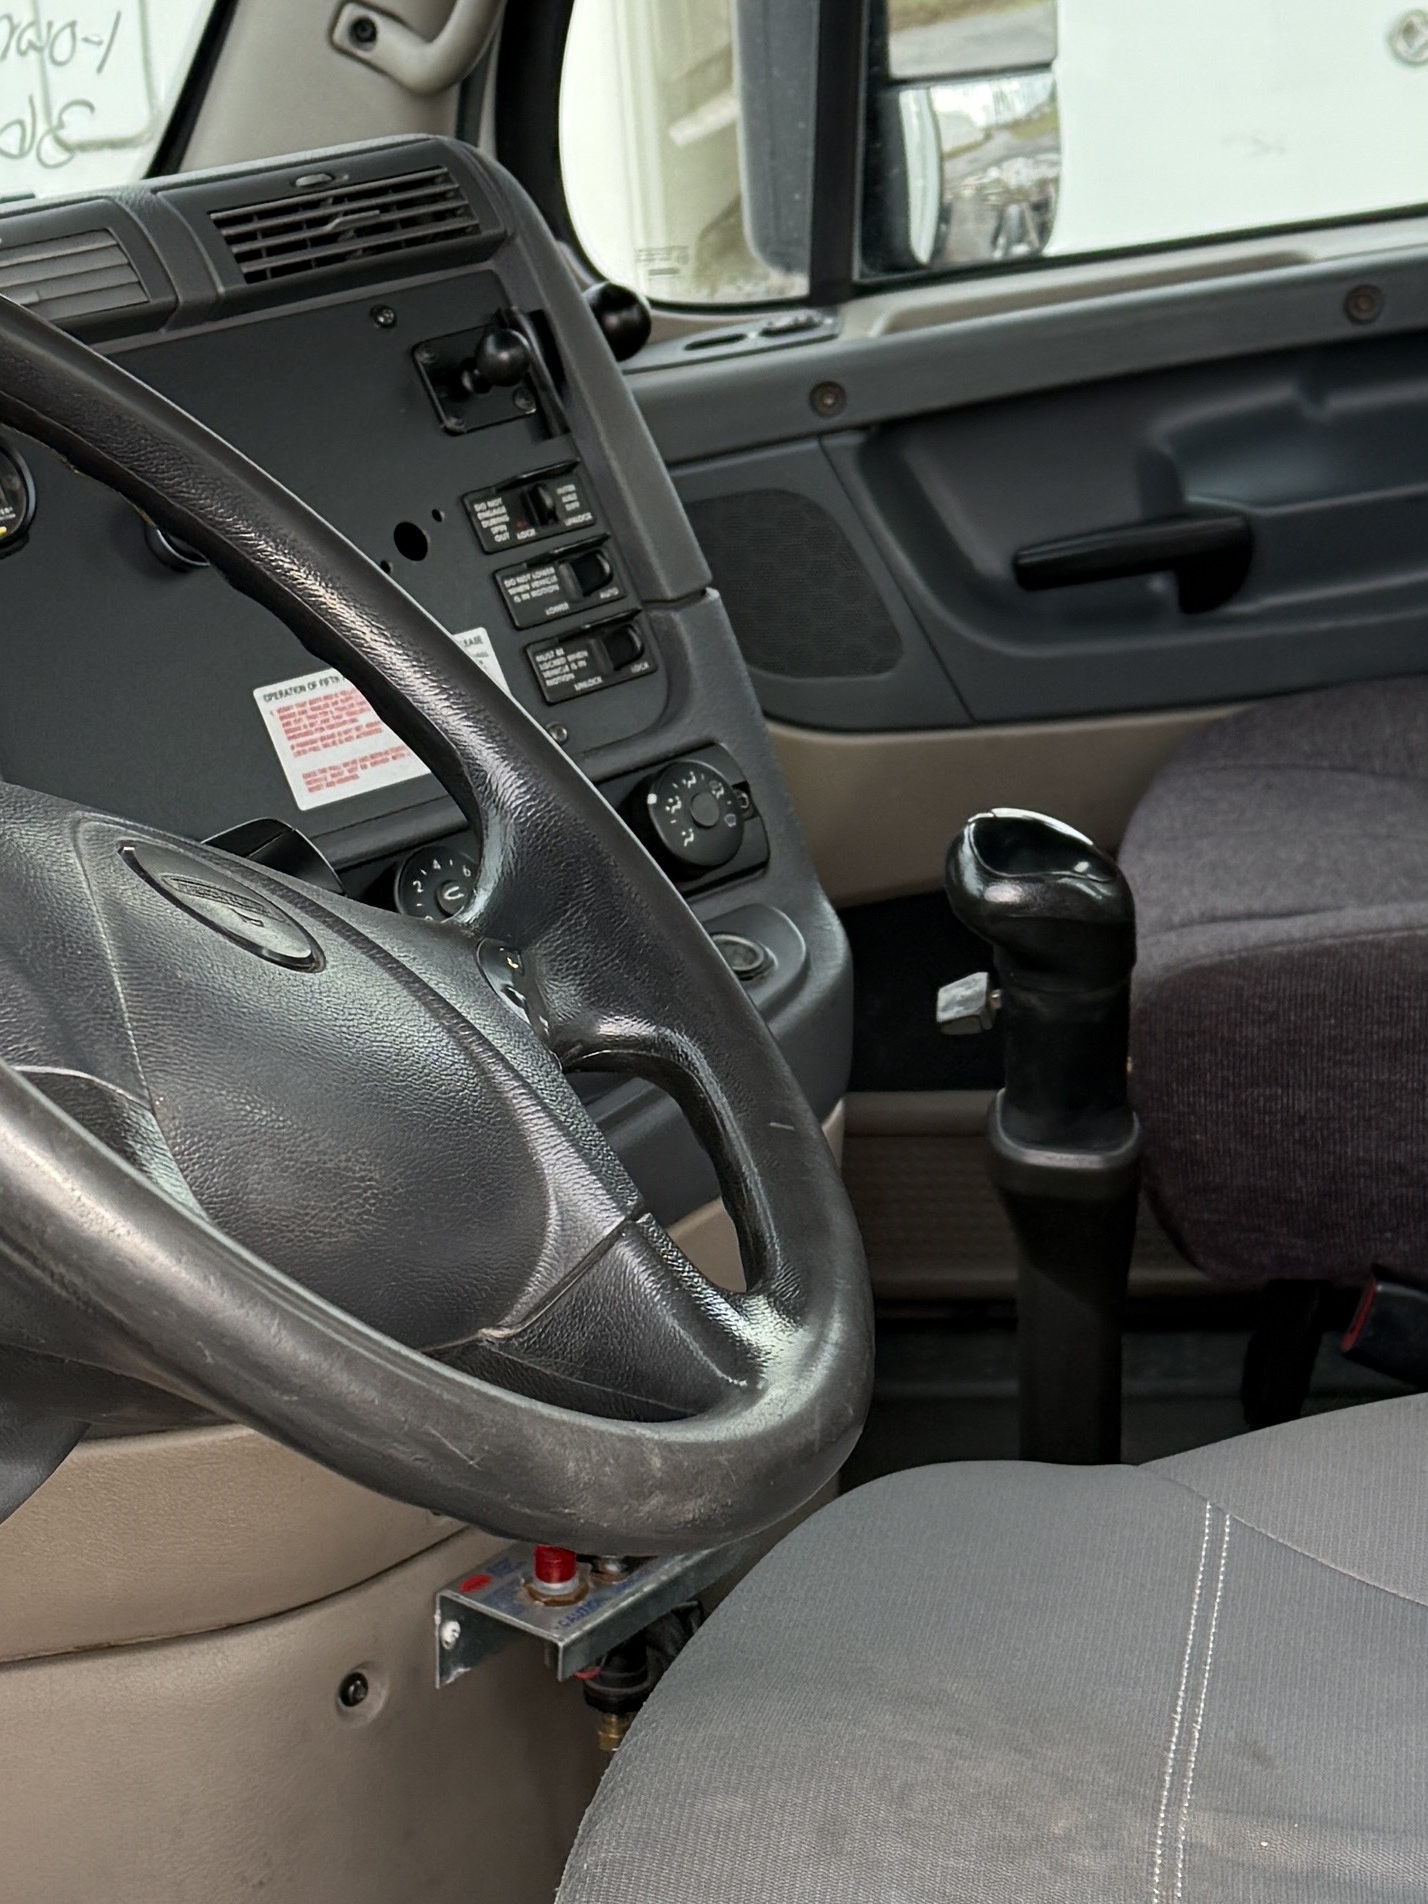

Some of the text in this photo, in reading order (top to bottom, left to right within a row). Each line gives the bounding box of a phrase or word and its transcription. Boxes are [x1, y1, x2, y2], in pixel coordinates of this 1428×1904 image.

[565, 512, 592, 526] UNLOCK
[517, 528, 536, 540] LOCK
[630, 662, 650, 674] LOCK
[574, 676, 603, 691] UNLOCK
[263, 682, 307, 703] OPERATION
[412, 858, 473, 894] 2 4 6
